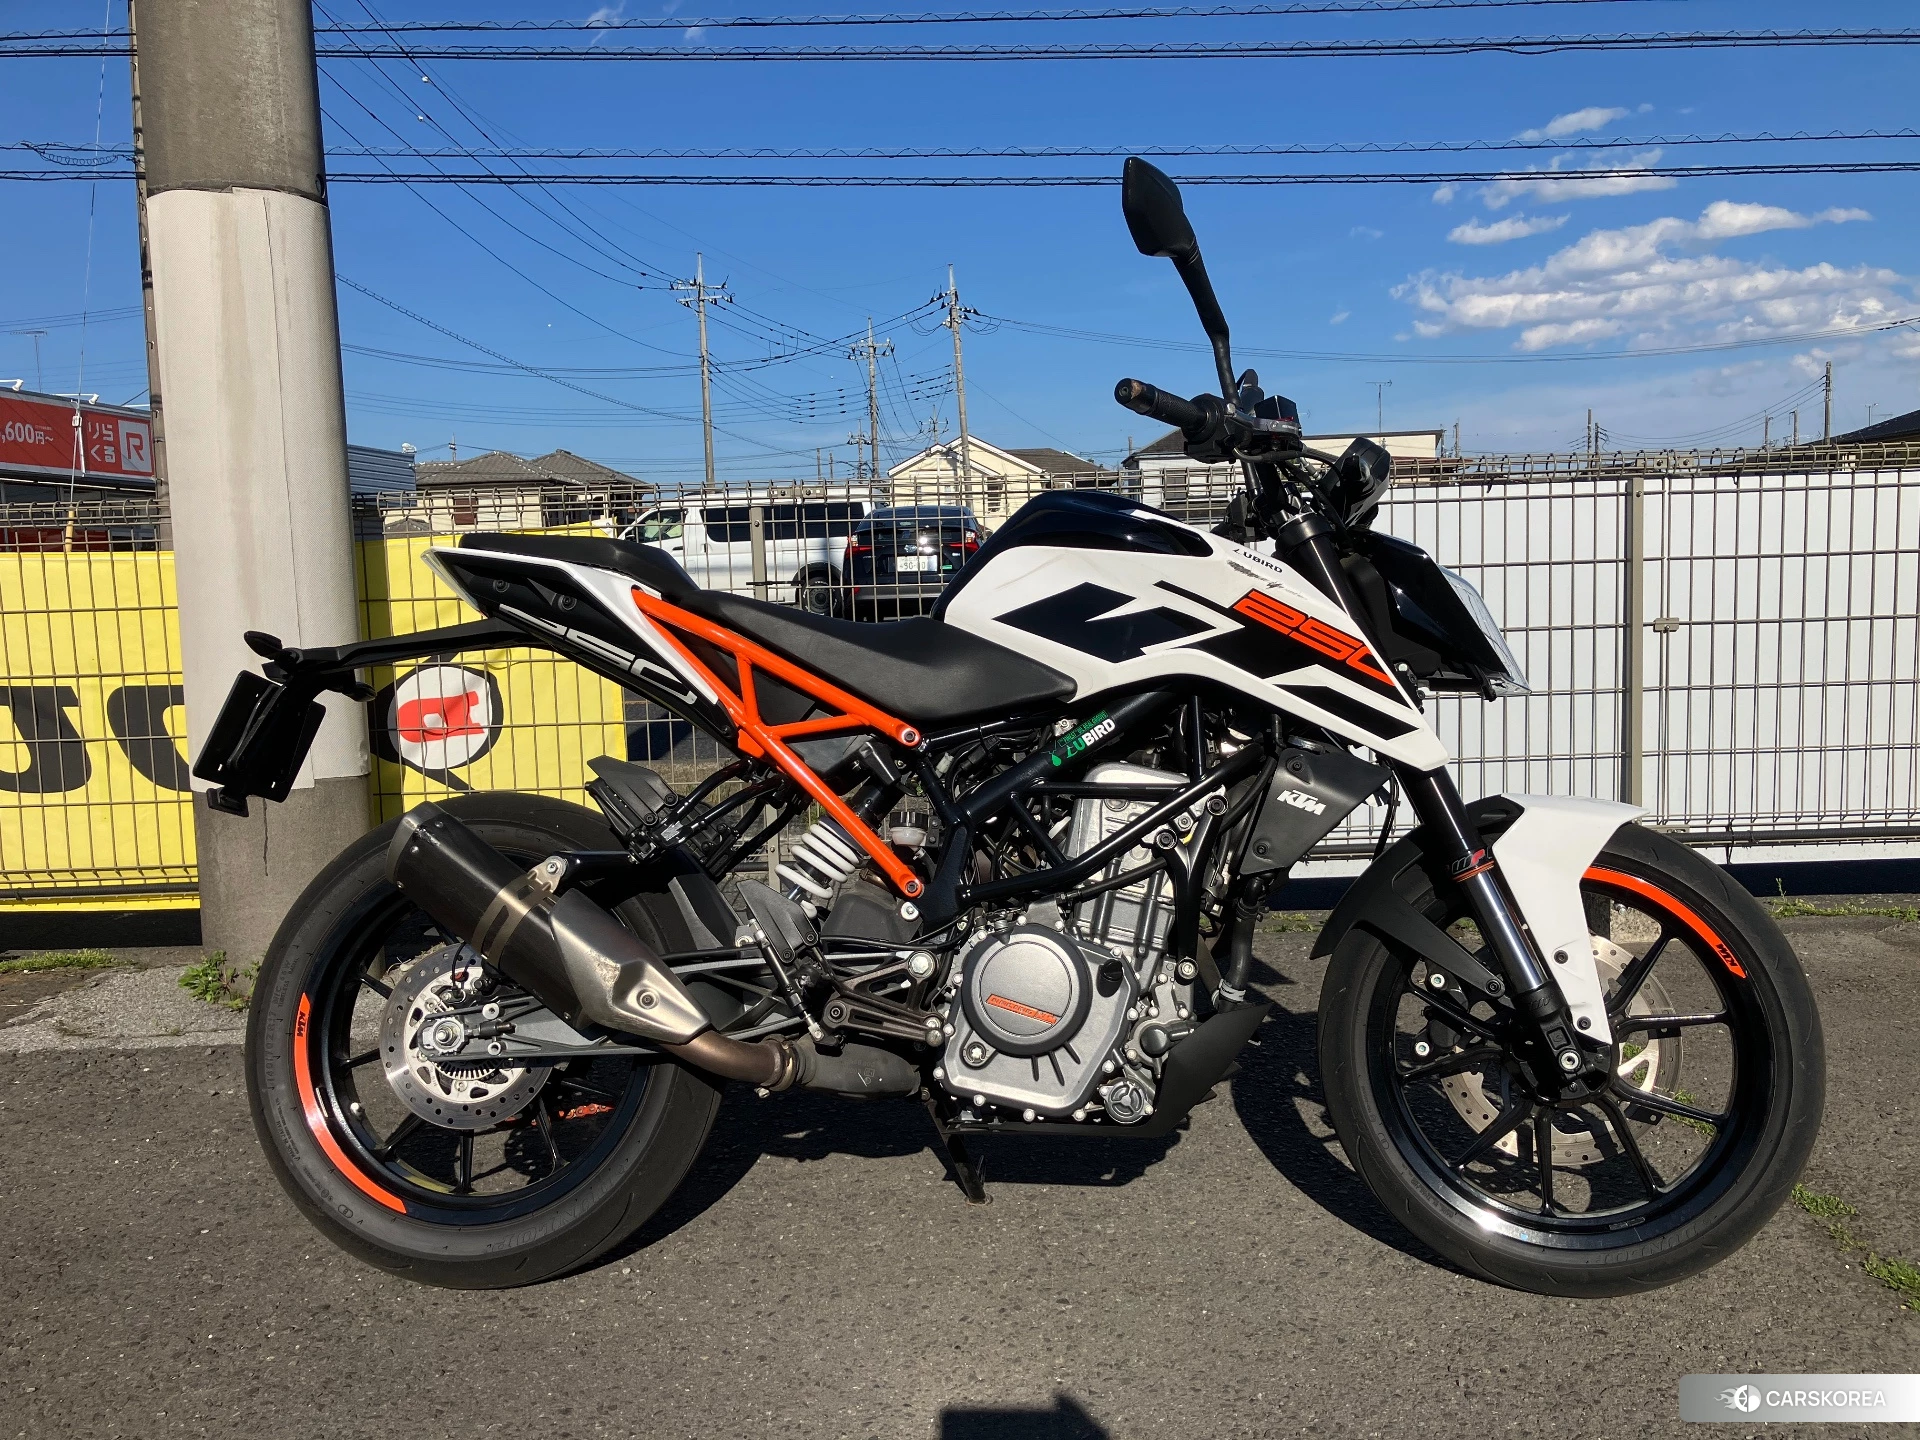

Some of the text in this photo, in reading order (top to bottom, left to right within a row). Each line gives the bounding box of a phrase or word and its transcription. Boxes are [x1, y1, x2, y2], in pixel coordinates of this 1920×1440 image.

[126, 432, 145, 462] R
[1276, 789, 1327, 816] KTM
[1715, 942, 1739, 967] KTM
[296, 1010, 306, 1038] KTM
